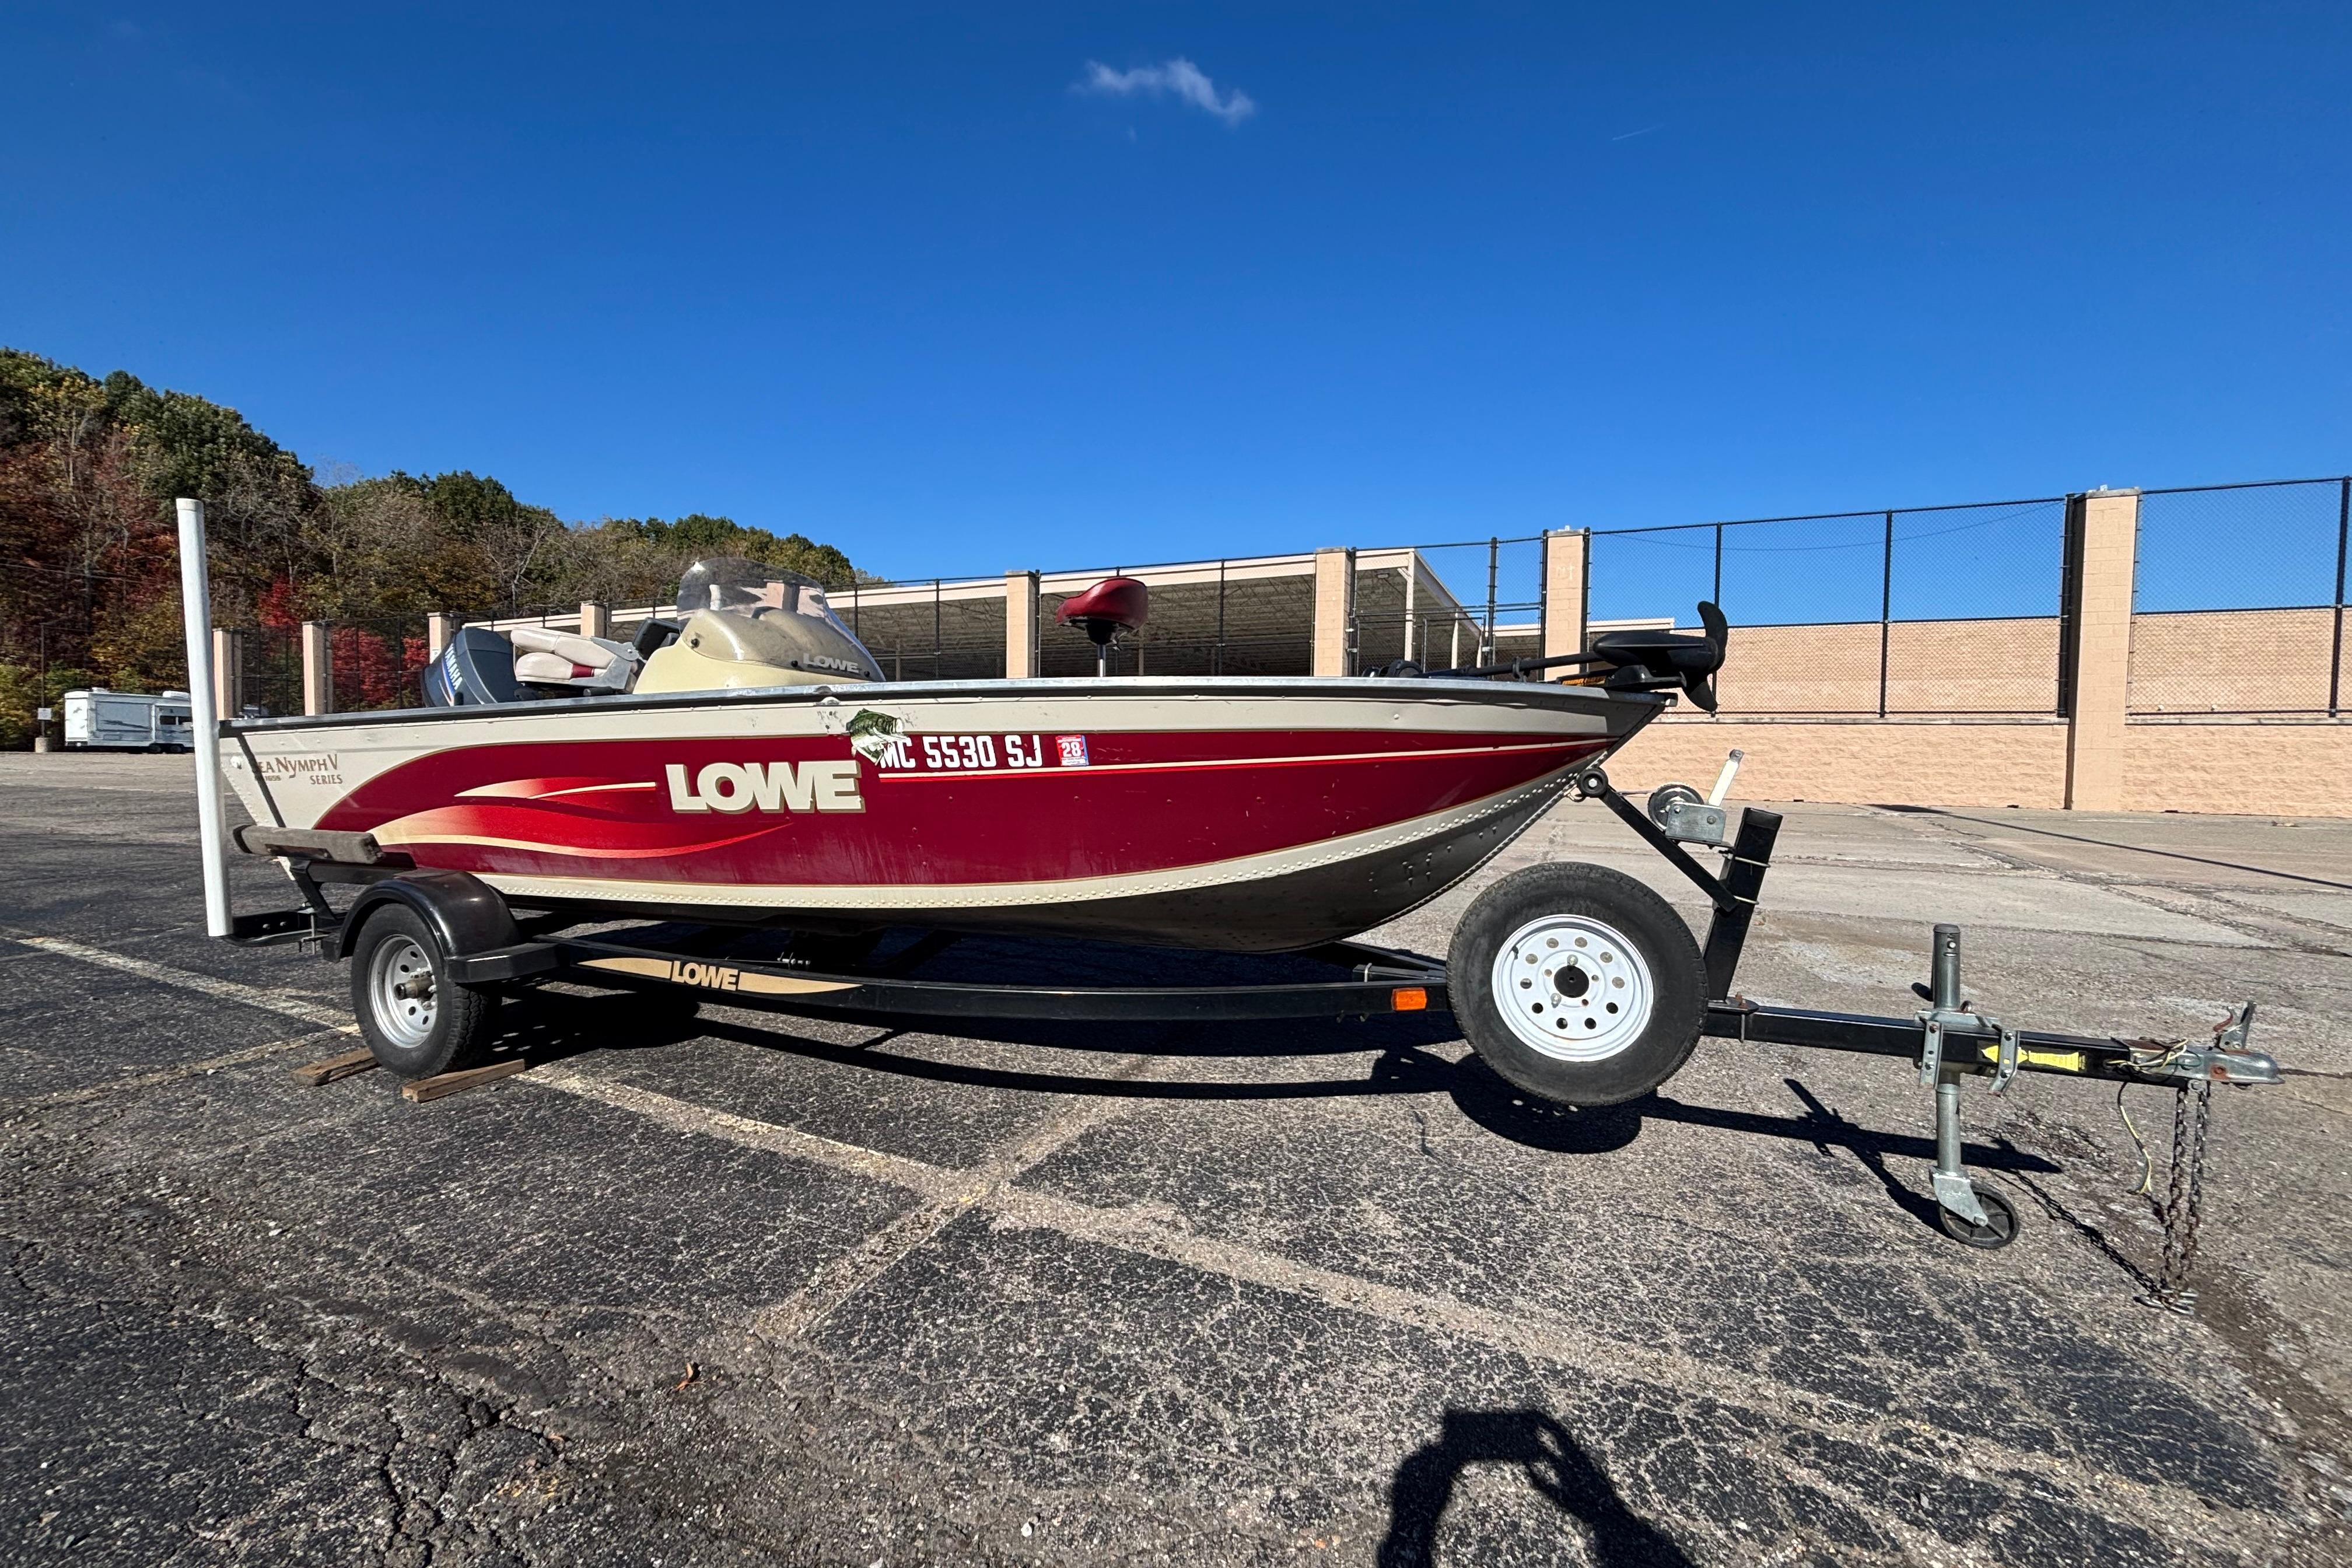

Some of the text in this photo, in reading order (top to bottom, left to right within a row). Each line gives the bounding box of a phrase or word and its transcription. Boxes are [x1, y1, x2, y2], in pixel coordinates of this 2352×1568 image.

[444, 642, 463, 690] YAMAHA
[803, 653, 859, 673] LOWE
[880, 734, 1042, 769] MC 5530 SJ
[1061, 741, 1082, 757] 28
[327, 754, 337, 770] V
[310, 774, 343, 785] SERIES
[665, 760, 866, 813] LOWE
[671, 960, 738, 991] LOWE
